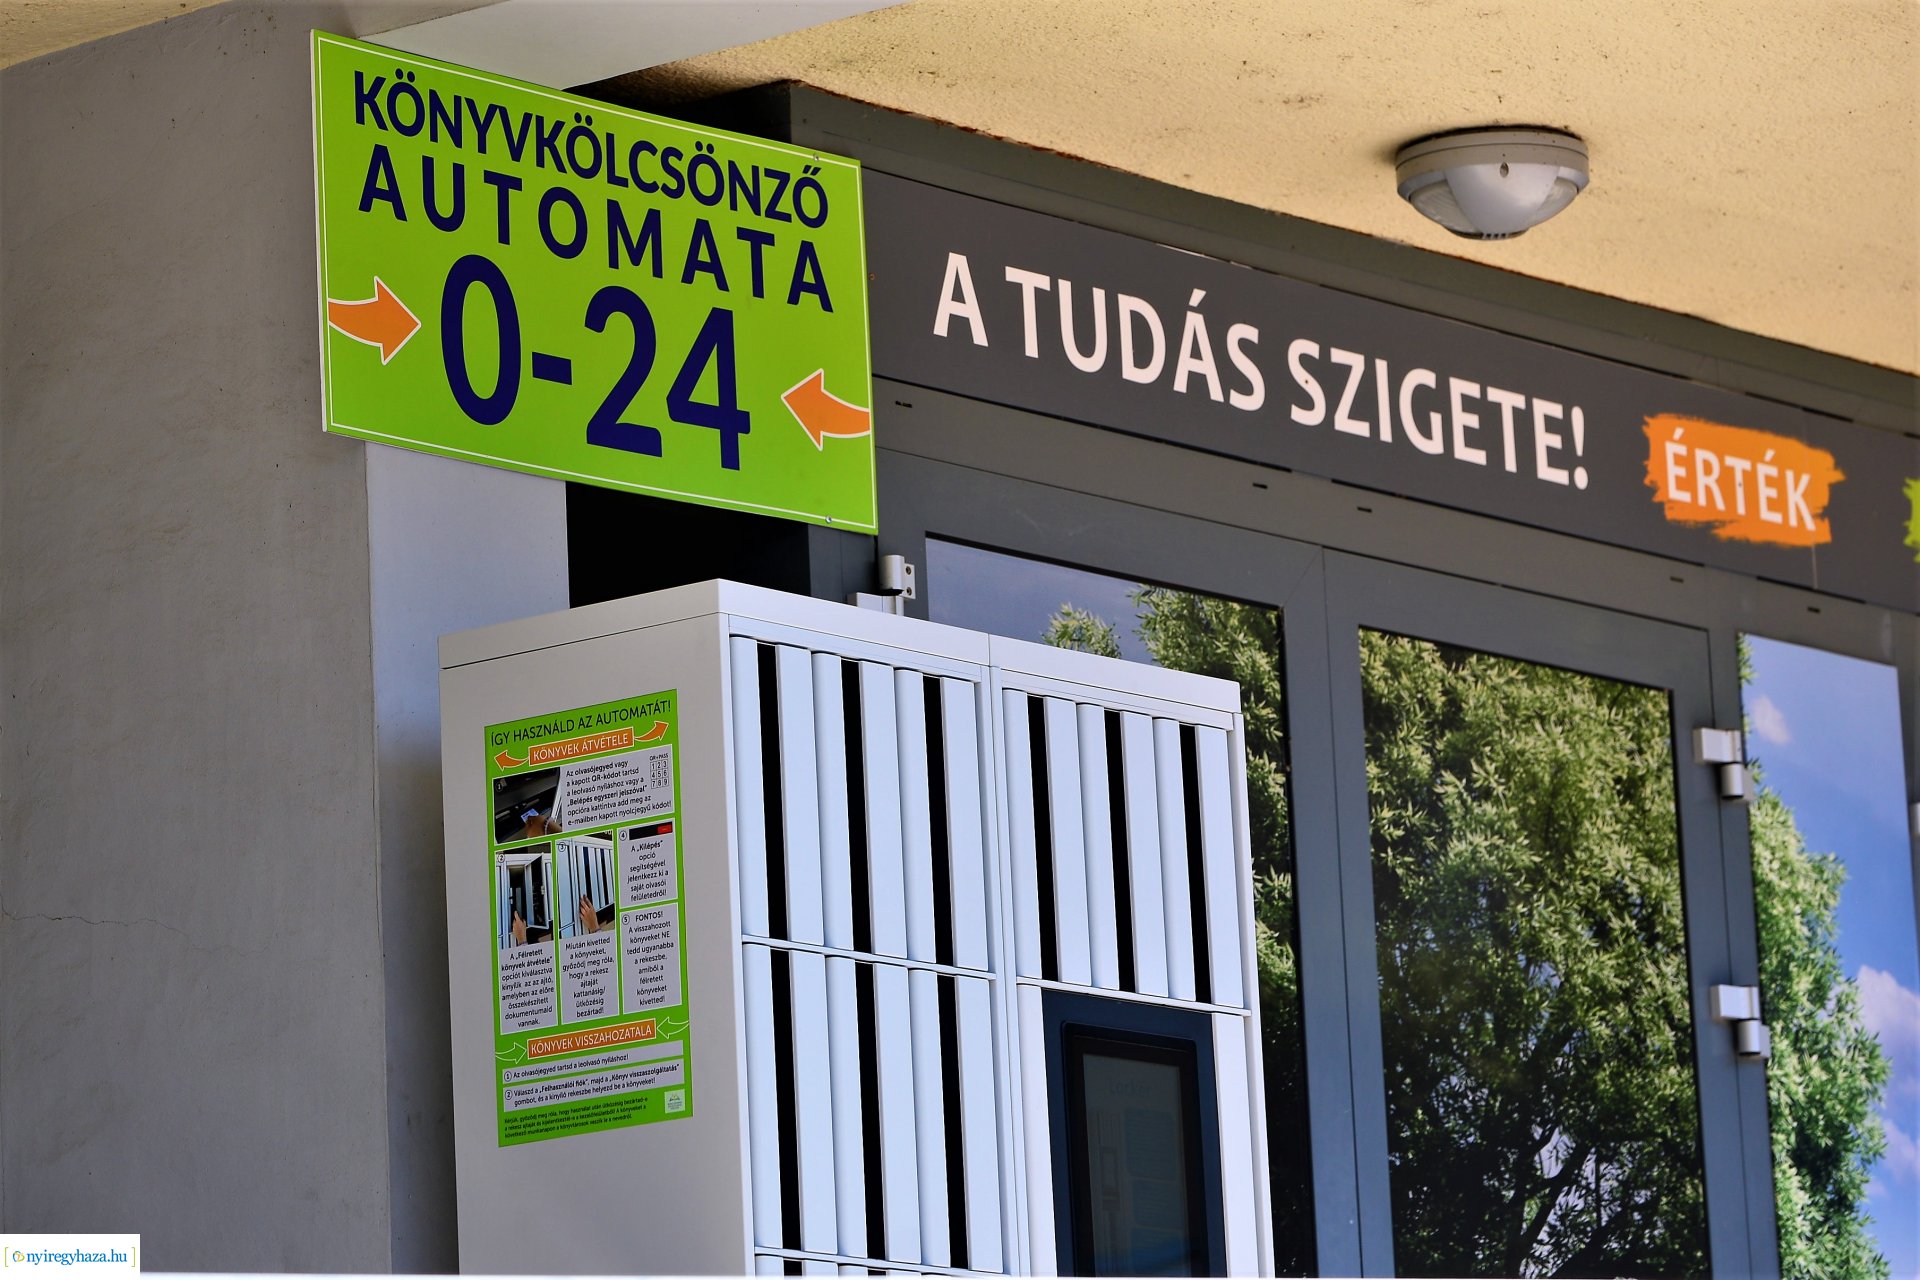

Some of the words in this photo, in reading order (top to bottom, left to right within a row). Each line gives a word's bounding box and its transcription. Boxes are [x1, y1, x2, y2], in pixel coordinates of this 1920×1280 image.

[354, 69, 829, 229] KÖNYVKÖLCSÖNZŐ
[359, 144, 833, 312] AUTOMATA
[441, 255, 750, 470] 0-24
[934, 253, 988, 346] A
[1006, 267, 1265, 410] TUDÁS
[1288, 339, 1588, 489] SZIGETE!
[1666, 428, 1815, 530] ÉRTÉK
[491, 731, 510, 747] ÍGY
[513, 719, 574, 742] HASZNÁLD
[577, 715, 592, 730] AZ
[596, 699, 670, 726] AUTOMATÁT!
[533, 743, 579, 761] KÖNYVEK
[581, 733, 628, 752] ÁTVÉTELE
[614, 760, 628, 768] vagy
[625, 778, 639, 786] vagy
[617, 798, 629, 806] add
[638, 851, 656, 861] opció
[658, 869, 664, 877] ki
[630, 883, 644, 892] saját
[628, 926, 633, 934] A
[661, 930, 670, 938] NE
[626, 946, 640, 955] tedd
[568, 972, 584, 980] hogy
[539, 986, 554, 994] előre
[531, 1038, 573, 1054] KÖNYVEK
[574, 1024, 652, 1046] VISSZAHOZATALA
[590, 1076, 604, 1084] majd
